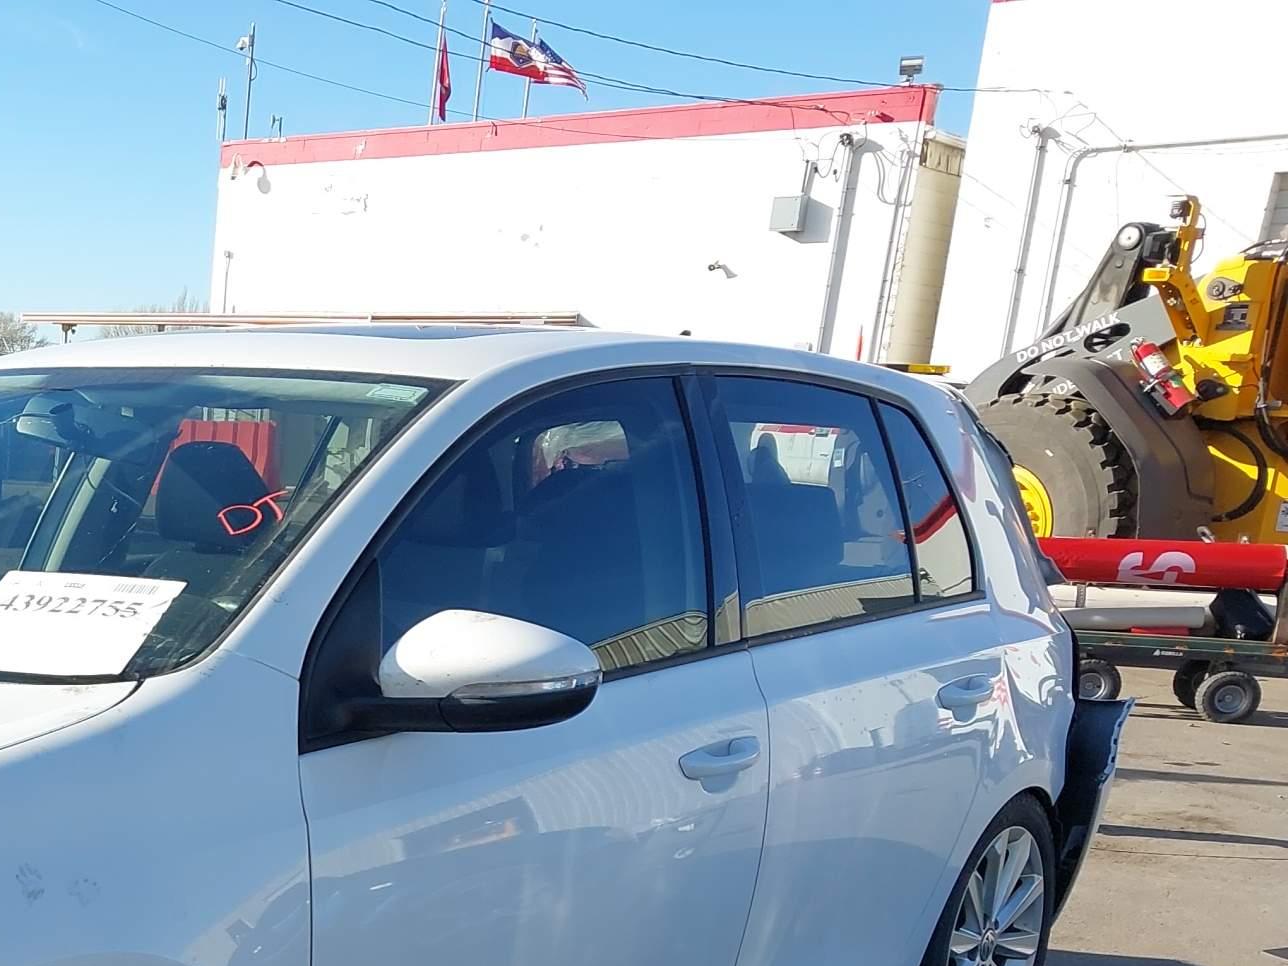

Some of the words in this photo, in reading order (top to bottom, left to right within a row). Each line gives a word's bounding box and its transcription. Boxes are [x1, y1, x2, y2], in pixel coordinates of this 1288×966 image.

[1016, 346, 1039, 363] DO
[1041, 331, 1075, 352] NOT
[1076, 312, 1121, 338] WALK
[217, 490, 289, 535] DT
[0, 593, 144, 618] 43922755
